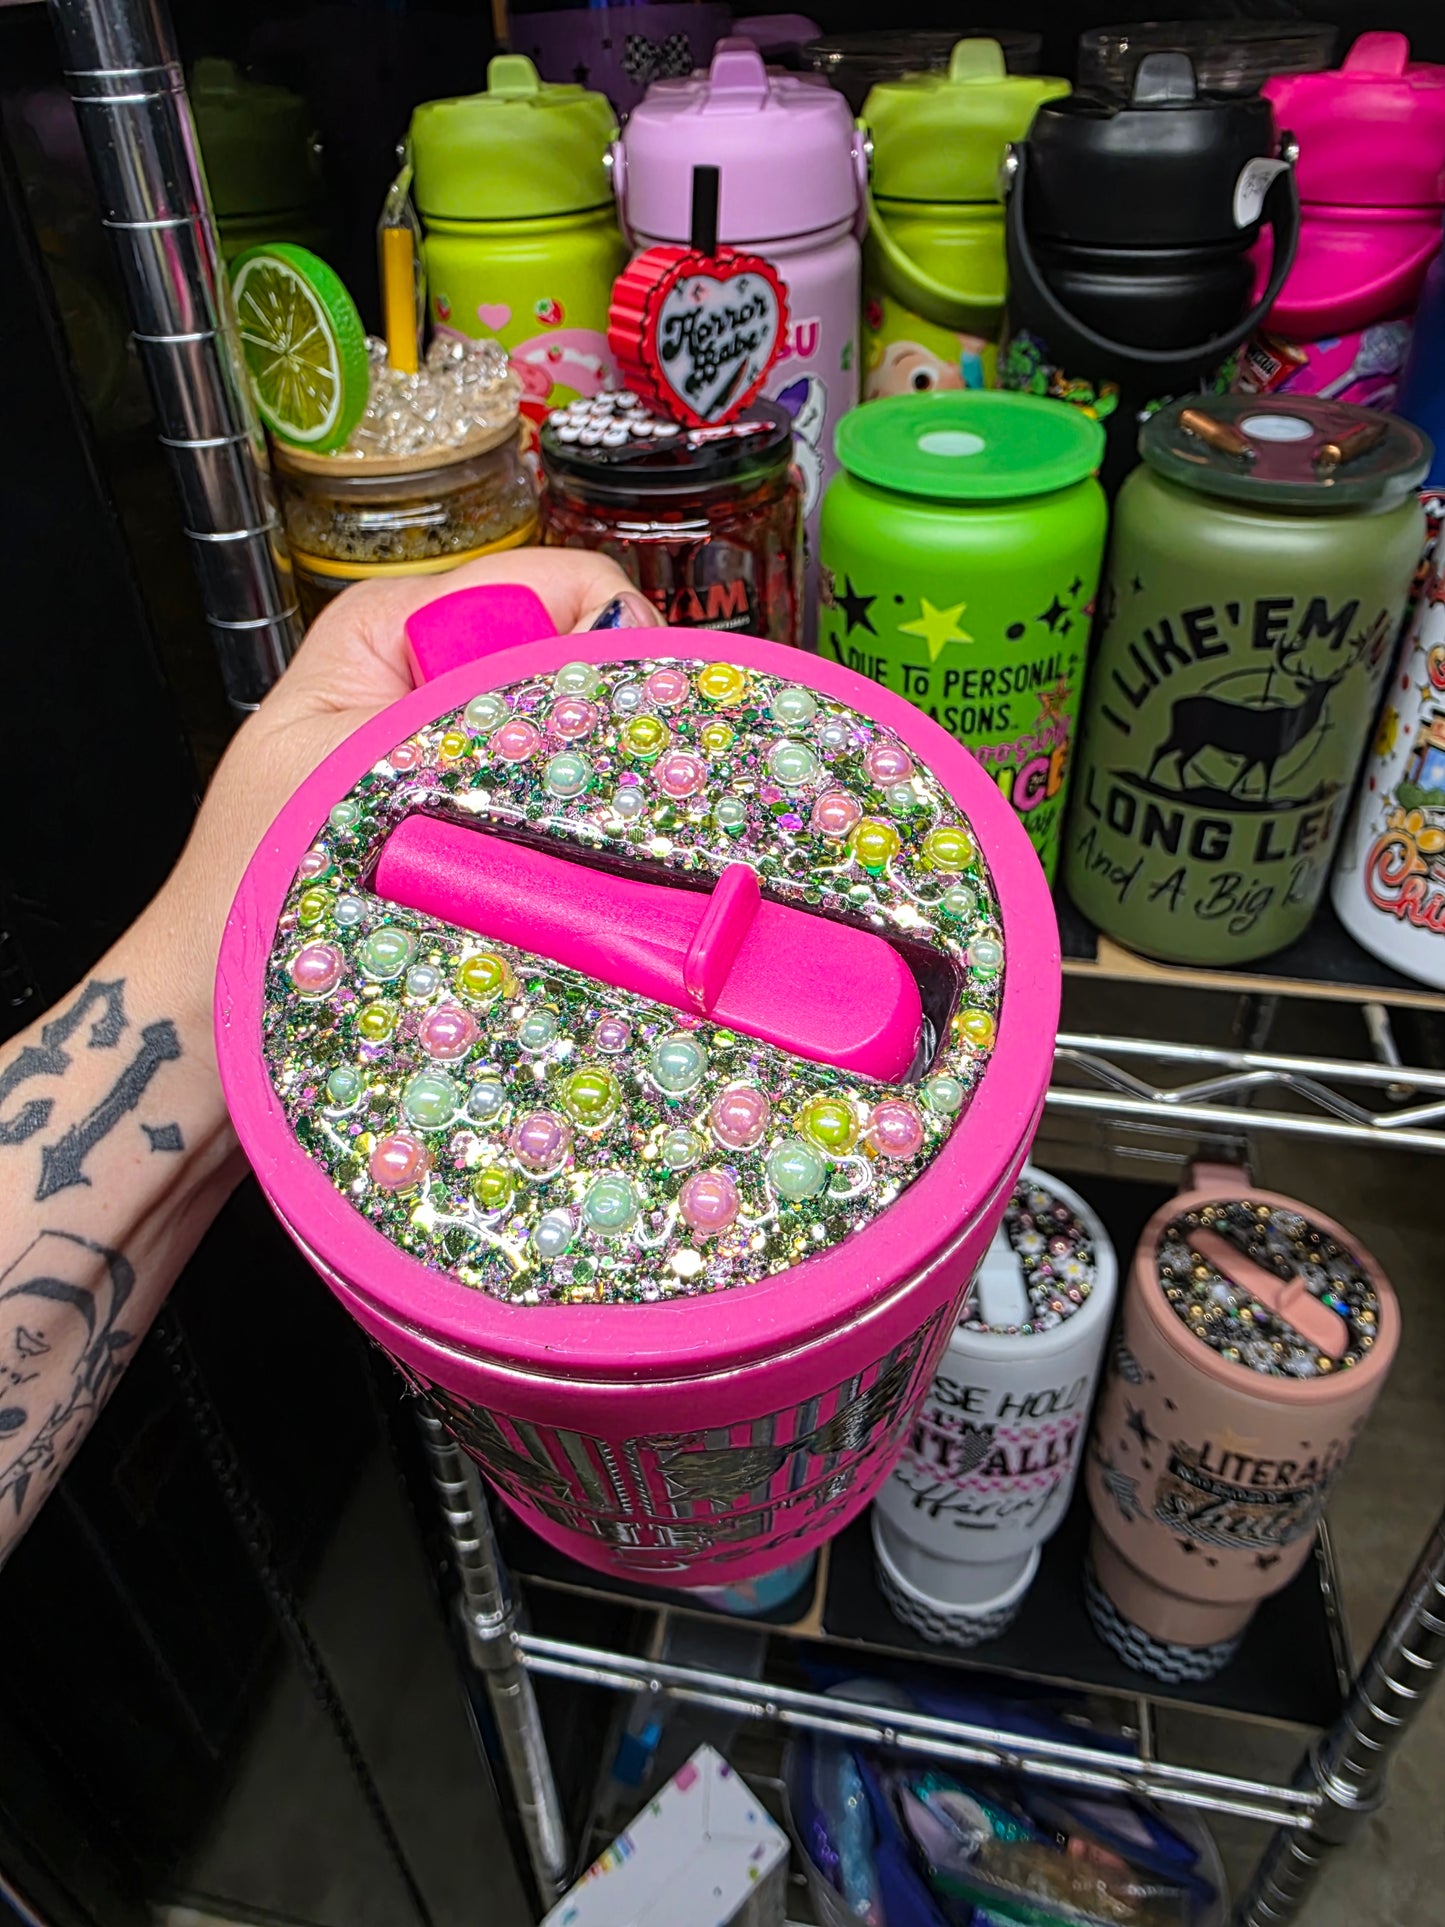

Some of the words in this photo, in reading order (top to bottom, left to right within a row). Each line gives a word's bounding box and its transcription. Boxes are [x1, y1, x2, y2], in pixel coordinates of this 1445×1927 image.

[661, 294, 769, 361] Horror
[943, 652, 1062, 699] PERSONAL
[1080, 764, 1233, 864] LONG
[1077, 827, 1145, 904] And
[1149, 867, 1188, 913] A
[1194, 871, 1276, 936] Big
